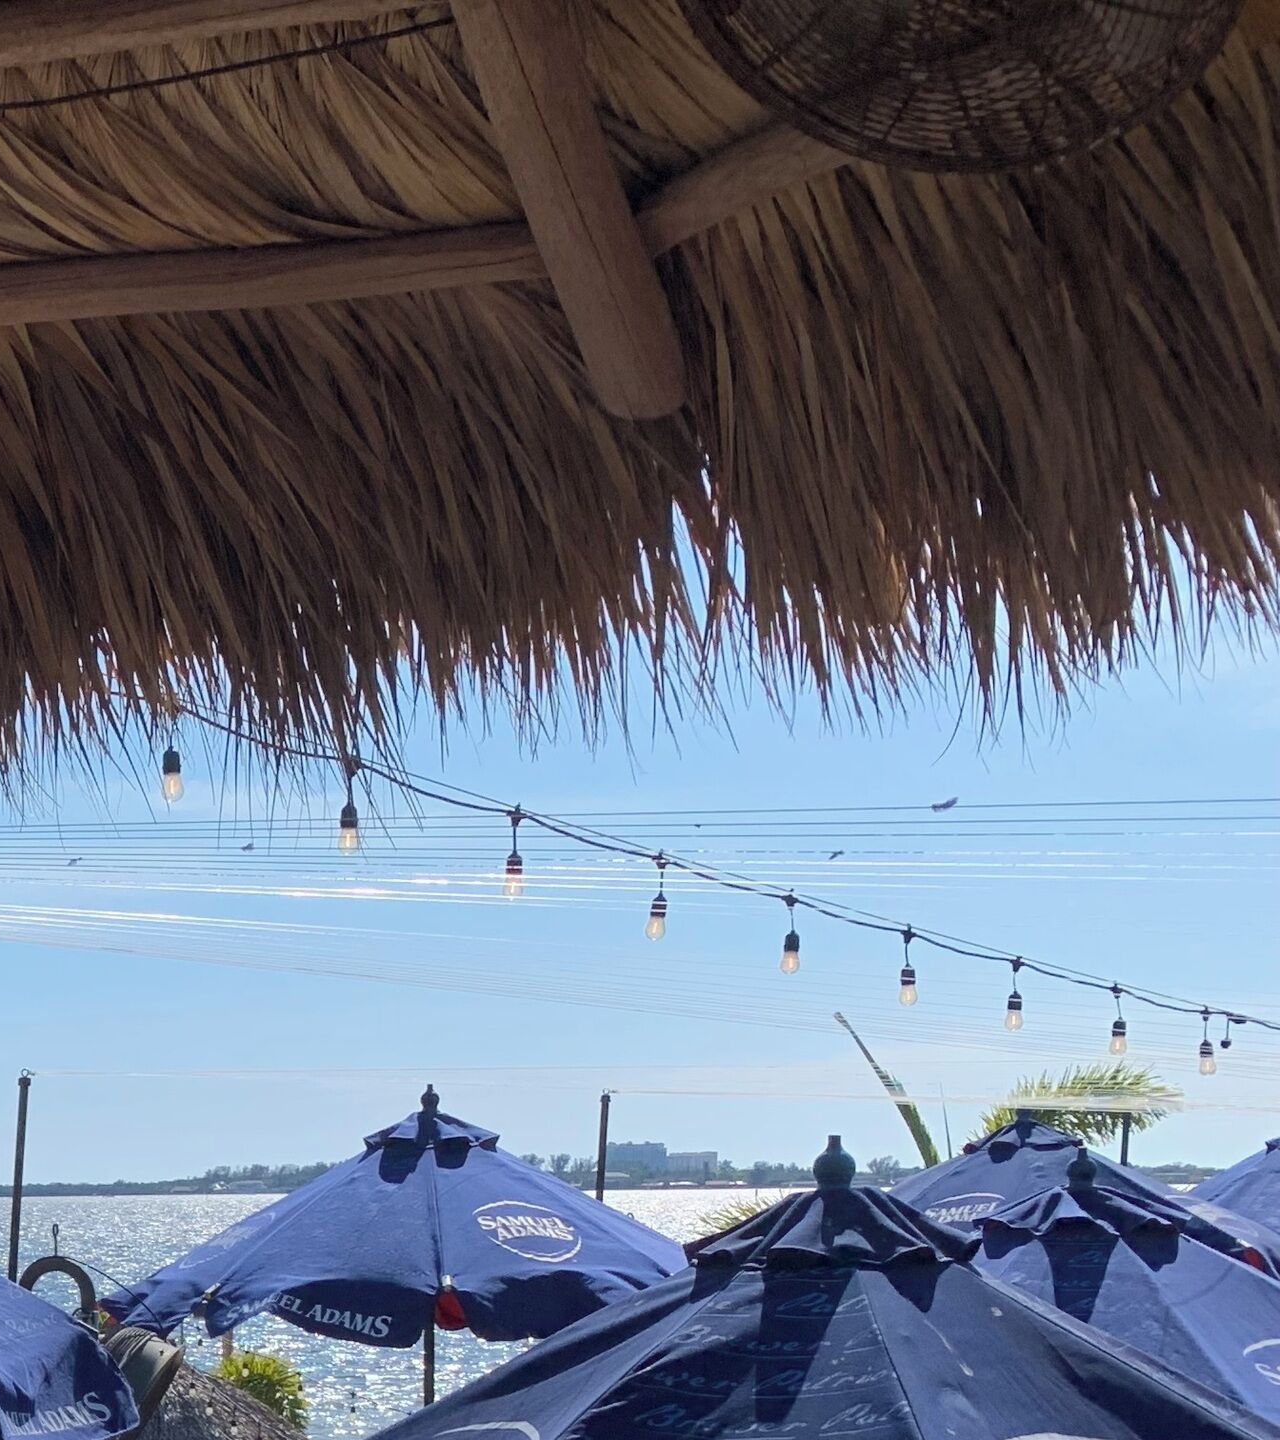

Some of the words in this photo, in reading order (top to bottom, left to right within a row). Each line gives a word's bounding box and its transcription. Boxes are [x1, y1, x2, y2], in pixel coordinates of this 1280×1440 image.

[476, 1215, 575, 1230] SAMUEL
[497, 1226, 574, 1241] ADAMS
[304, 1304, 393, 1338] ADAMS
[36, 1391, 112, 1435] ADAMS
